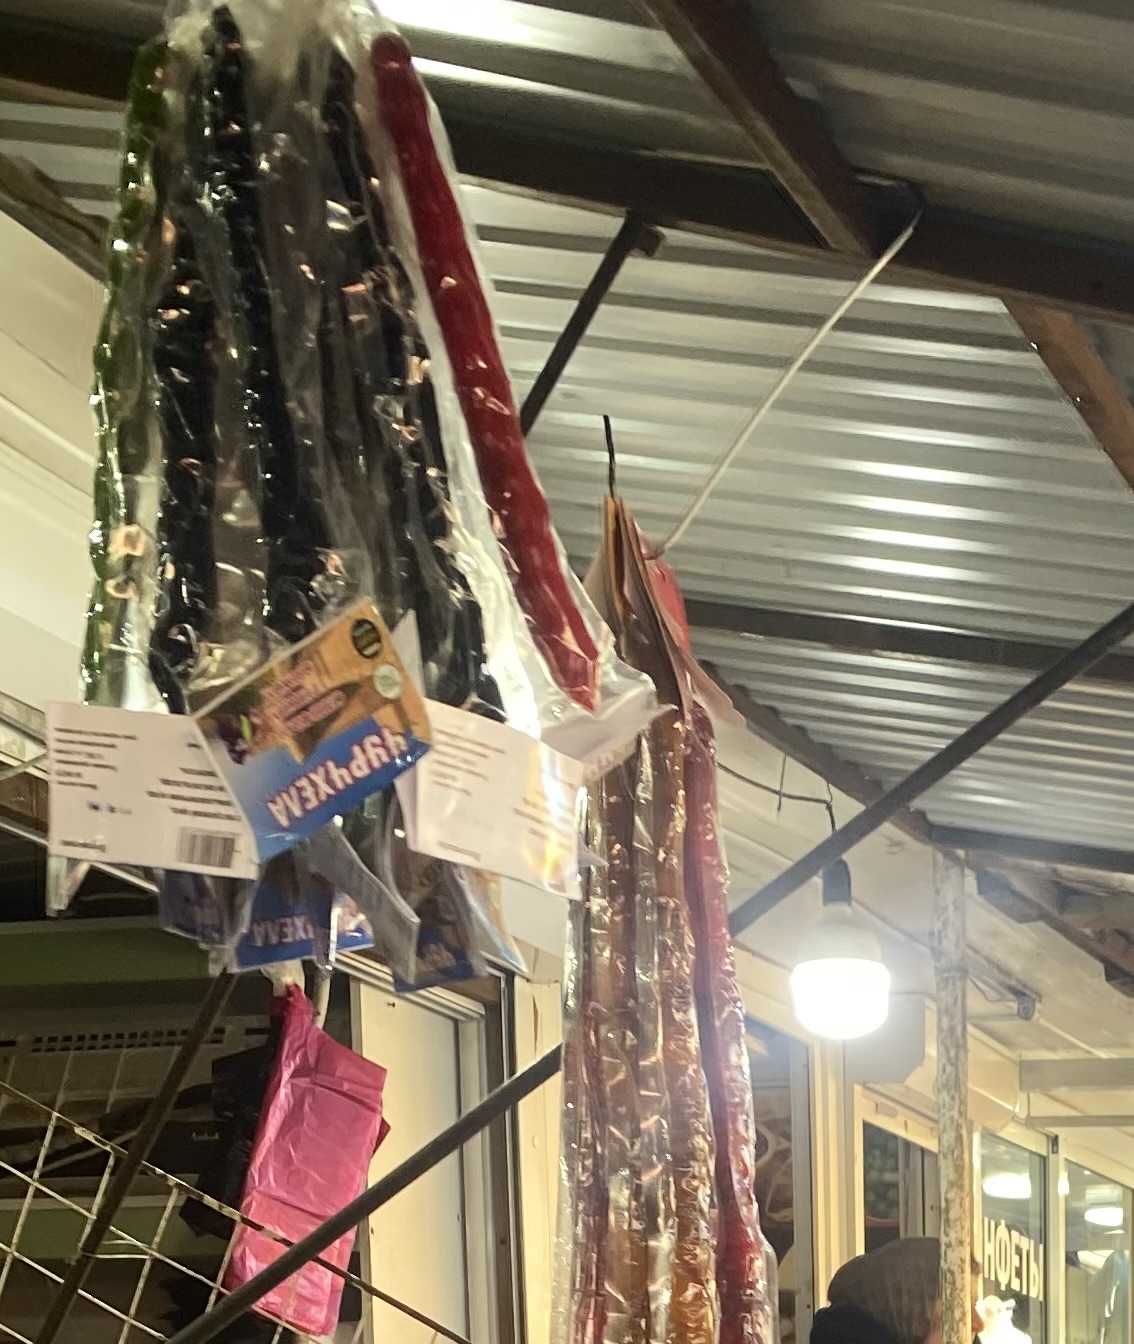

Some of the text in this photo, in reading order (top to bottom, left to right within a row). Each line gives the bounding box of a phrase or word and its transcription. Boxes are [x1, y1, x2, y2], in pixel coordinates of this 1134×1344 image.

[266, 727, 409, 829] ЧУРЧХЕЛА
[252, 915, 315, 948] ХЕЛА
[983, 1216, 1044, 1302] НФЕТЫ
